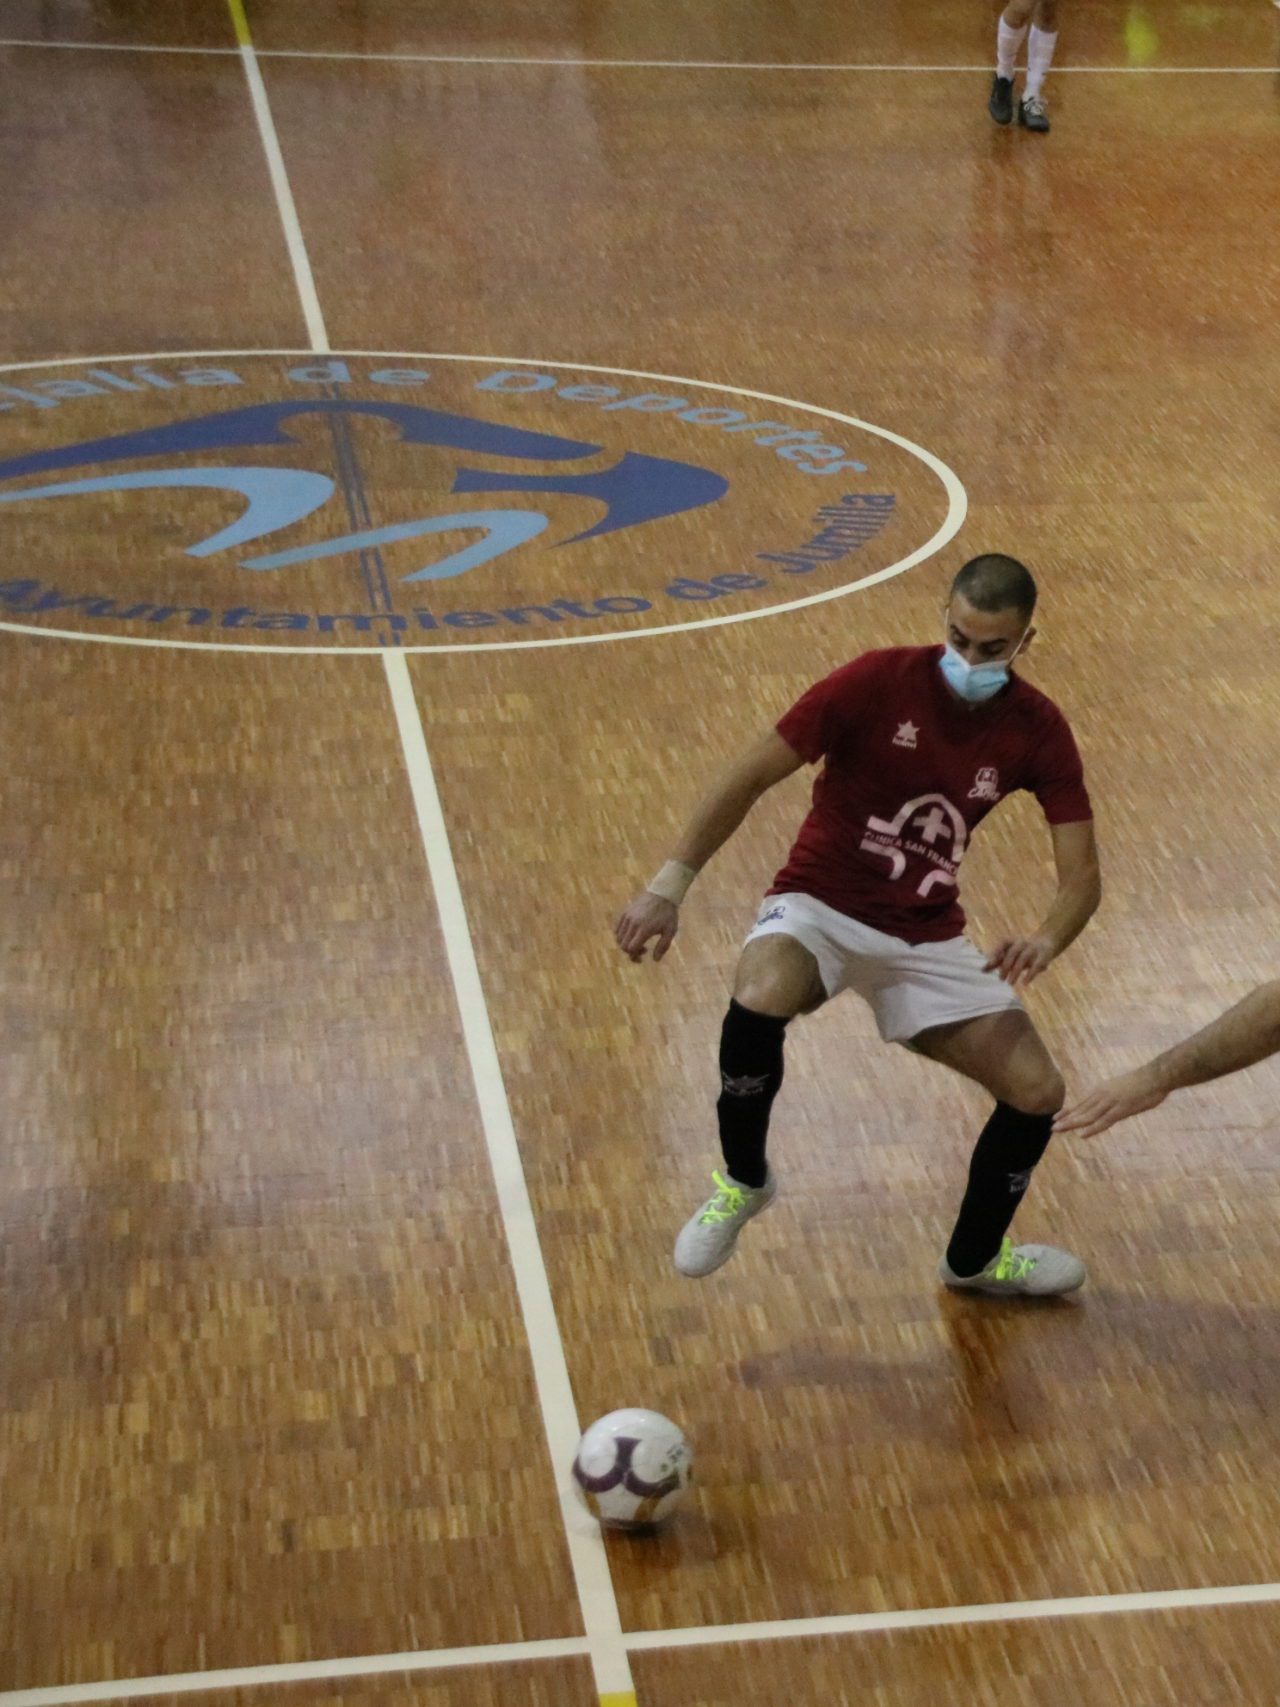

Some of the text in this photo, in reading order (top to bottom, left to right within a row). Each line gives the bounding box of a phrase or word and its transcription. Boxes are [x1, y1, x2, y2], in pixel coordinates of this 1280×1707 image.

[288, 360, 431, 385] de
[474, 370, 868, 475] Deportes
[665, 573, 768, 601] de
[756, 494, 896, 574] Jumilla
[904, 840, 928, 855] SAN
[926, 848, 959, 876] FRANC
